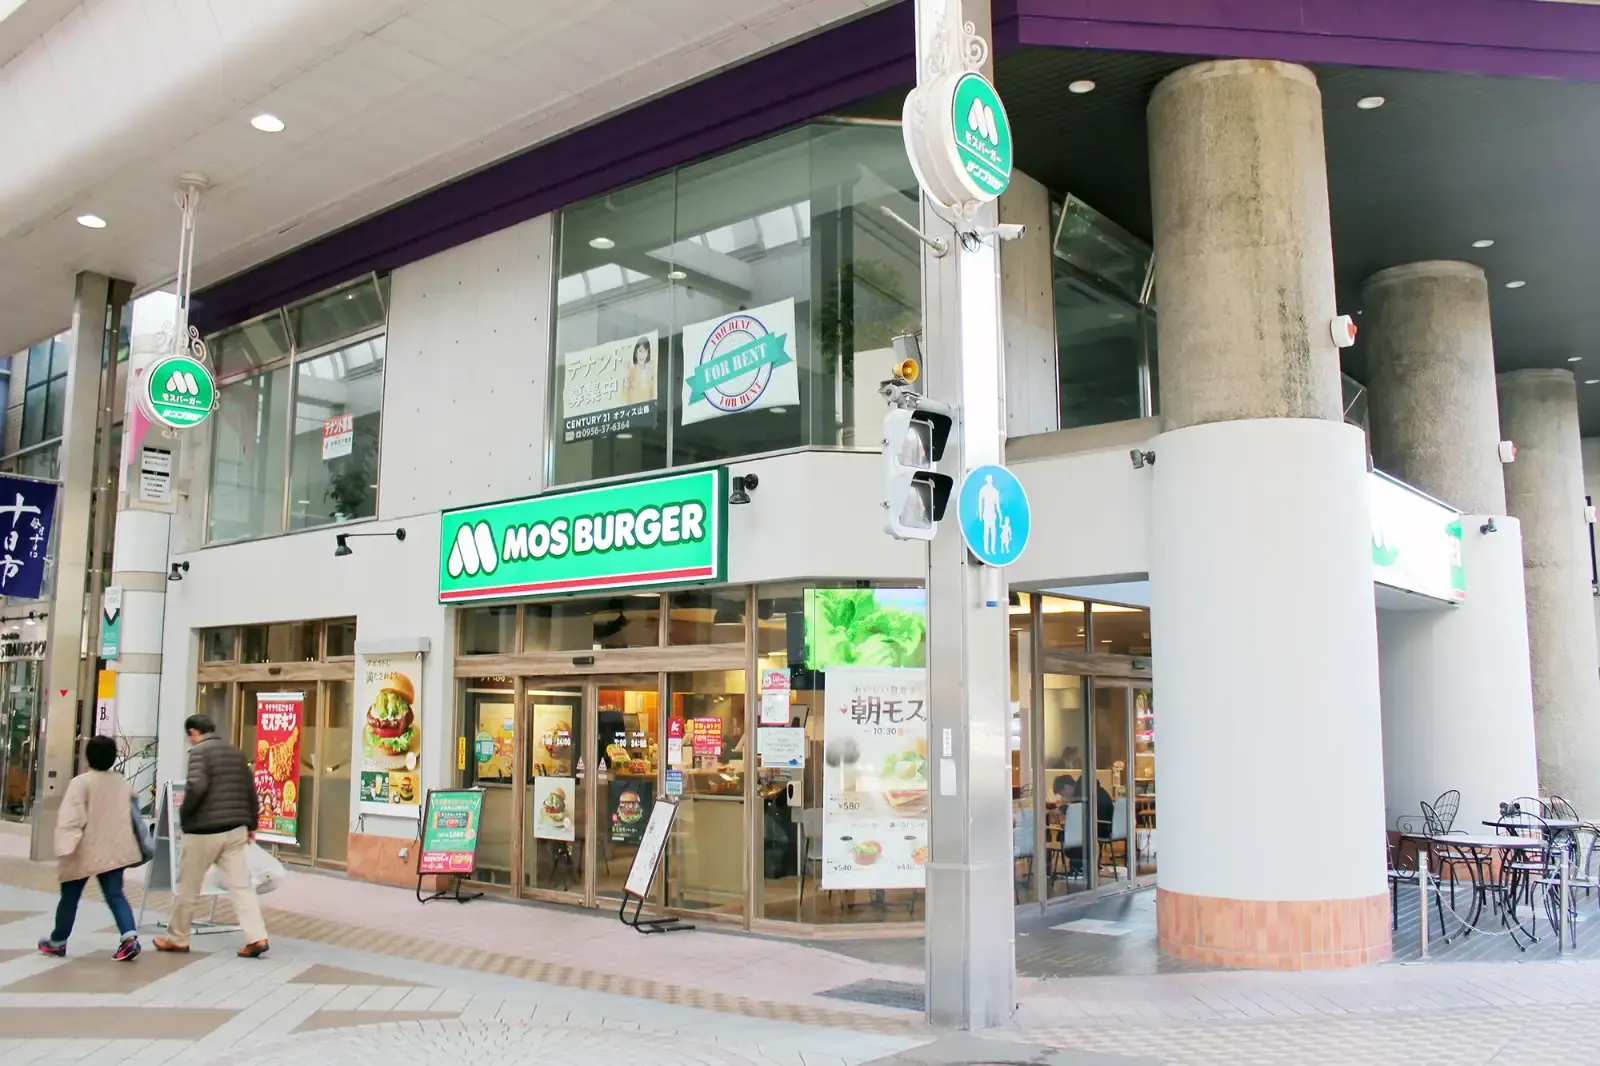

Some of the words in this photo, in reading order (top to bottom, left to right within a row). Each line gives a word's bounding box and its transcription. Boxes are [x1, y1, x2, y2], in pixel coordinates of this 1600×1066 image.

[710, 326, 727, 346] FOR
[728, 319, 752, 331] RENT
[567, 348, 623, 381] テナント
[703, 360, 730, 384] FOR
[731, 342, 767, 372] RENT
[162, 393, 202, 405] モスバーガー
[567, 377, 619, 409] 募集中
[719, 395, 737, 408] FOR
[739, 381, 762, 405] RENT
[566, 415, 601, 430] CENTURY
[603, 412, 611, 423] 21
[501, 517, 571, 562] MOS
[573, 501, 705, 554] BURGER
[261, 711, 297, 731] モスチキン
[851, 695, 927, 726] 朝モス
[873, 727, 897, 736] 10:30
